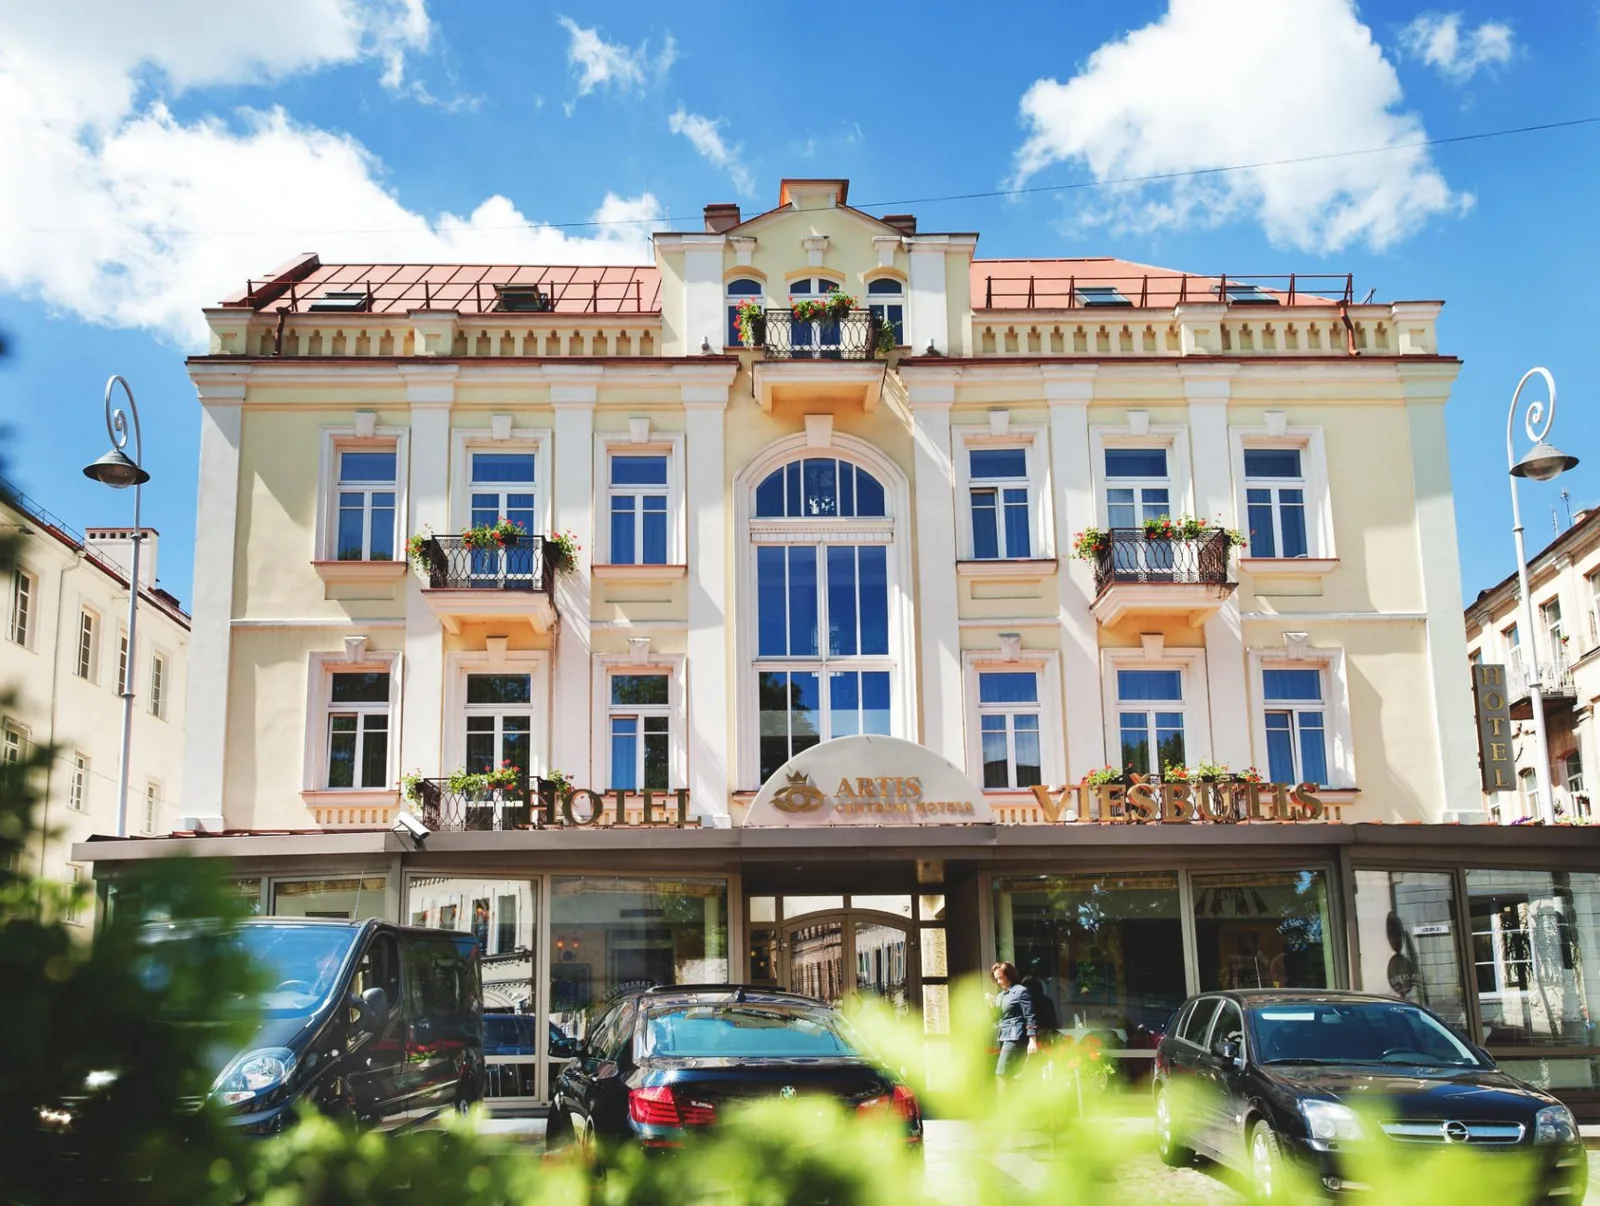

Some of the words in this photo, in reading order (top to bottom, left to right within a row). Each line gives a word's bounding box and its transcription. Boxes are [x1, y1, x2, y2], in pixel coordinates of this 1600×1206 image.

[1481, 667, 1510, 788] HOTEL
[834, 776, 922, 799] ARTIS
[1028, 772, 1324, 822] VIEŠBUTIS
[515, 788, 702, 826] HOTEL
[835, 802, 909, 814] CENTRUM
[915, 801, 975, 814] HOTELS
